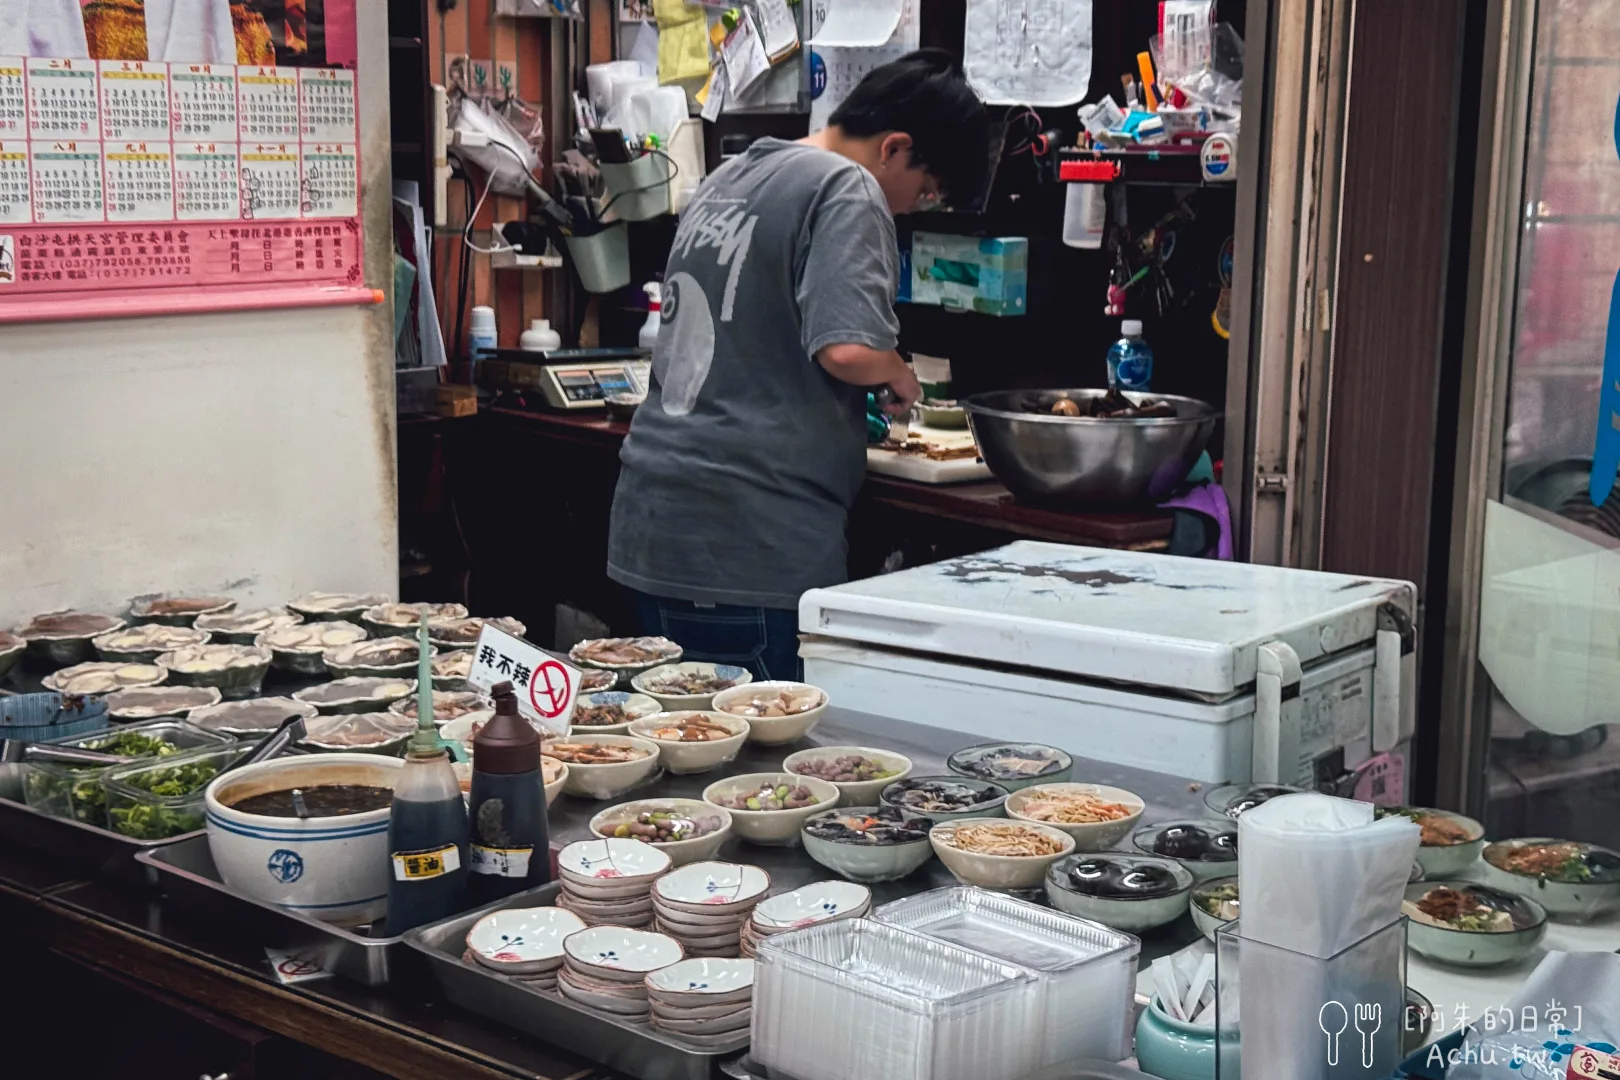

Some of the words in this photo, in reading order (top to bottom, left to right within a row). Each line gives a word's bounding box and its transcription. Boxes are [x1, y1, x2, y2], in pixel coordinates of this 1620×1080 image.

[49, 59, 71, 69] 二月
[121, 62, 143, 72] 三月
[190, 65, 211, 74] 四月
[318, 69, 336, 79] 六月
[814, 72, 824, 88] 11
[40, 99, 49, 107] 10
[51, 99, 58, 108] 11
[59, 99, 68, 109] 12
[69, 100, 77, 108] 13
[79, 100, 87, 108] 14
[89, 100, 96, 108] 15
[41, 110, 49, 119] 17
[51, 110, 59, 119] 18
[69, 111, 78, 119] 20
[89, 111, 97, 120] 22
[41, 121, 50, 130] 24
[51, 121, 59, 130] 25
[61, 122, 69, 130] 26
[70, 121, 79, 131] 27
[54, 142, 76, 151] 八月
[126, 142, 147, 152] 九月
[194, 143, 216, 153] 十月
[256, 144, 286, 154] 十一月
[315, 144, 343, 154] 十二月
[136, 171, 143, 179] 10
[145, 171, 152, 179] 11
[153, 171, 160, 179] 12
[162, 171, 170, 179] 13
[230, 171, 236, 179] 11
[44, 180, 51, 188] 11
[53, 180, 60, 188] 12
[62, 180, 70, 188] 13
[71, 180, 80, 188] 14
[82, 178, 90, 188] 15
[94, 180, 101, 188] 16
[117, 182, 125, 190] 15
[136, 181, 144, 190] 17
[146, 182, 153, 190] 18
[163, 181, 171, 190] 20
[202, 181, 209, 189] 15
[220, 181, 228, 189] 17
[35, 190, 43, 198] 17
[44, 190, 52, 198] 18
[53, 190, 61, 198] 19
[72, 190, 80, 198] 21
[83, 190, 90, 198] 22
[93, 189, 101, 199] 23
[108, 192, 116, 201] 21
[118, 193, 125, 201] 22
[127, 192, 135, 201] 23
[136, 192, 144, 201] 24
[146, 192, 153, 201] 25
[154, 192, 161, 200] 26
[164, 192, 171, 201] 27
[186, 192, 193, 201] 20
[194, 192, 201, 201] 21
[202, 192, 210, 200] 22
[212, 192, 219, 201] 23
[221, 192, 228, 200] 24
[230, 192, 238, 200] 25
[45, 201, 53, 210] 25
[54, 201, 62, 209] 26
[63, 201, 71, 210] 27
[72, 201, 80, 209] 28
[83, 201, 91, 209] 29
[118, 203, 126, 211] 29
[128, 203, 135, 212] 30
[186, 202, 193, 211] 27
[194, 202, 202, 211] 28
[203, 202, 210, 211] 29
[212, 202, 220, 210] 30
[222, 202, 229, 210] 31
[37, 212, 44, 220] 31
[661, 284, 676, 320] 8
[479, 644, 532, 688] 我不辣
[407, 856, 439, 874] 醬油
